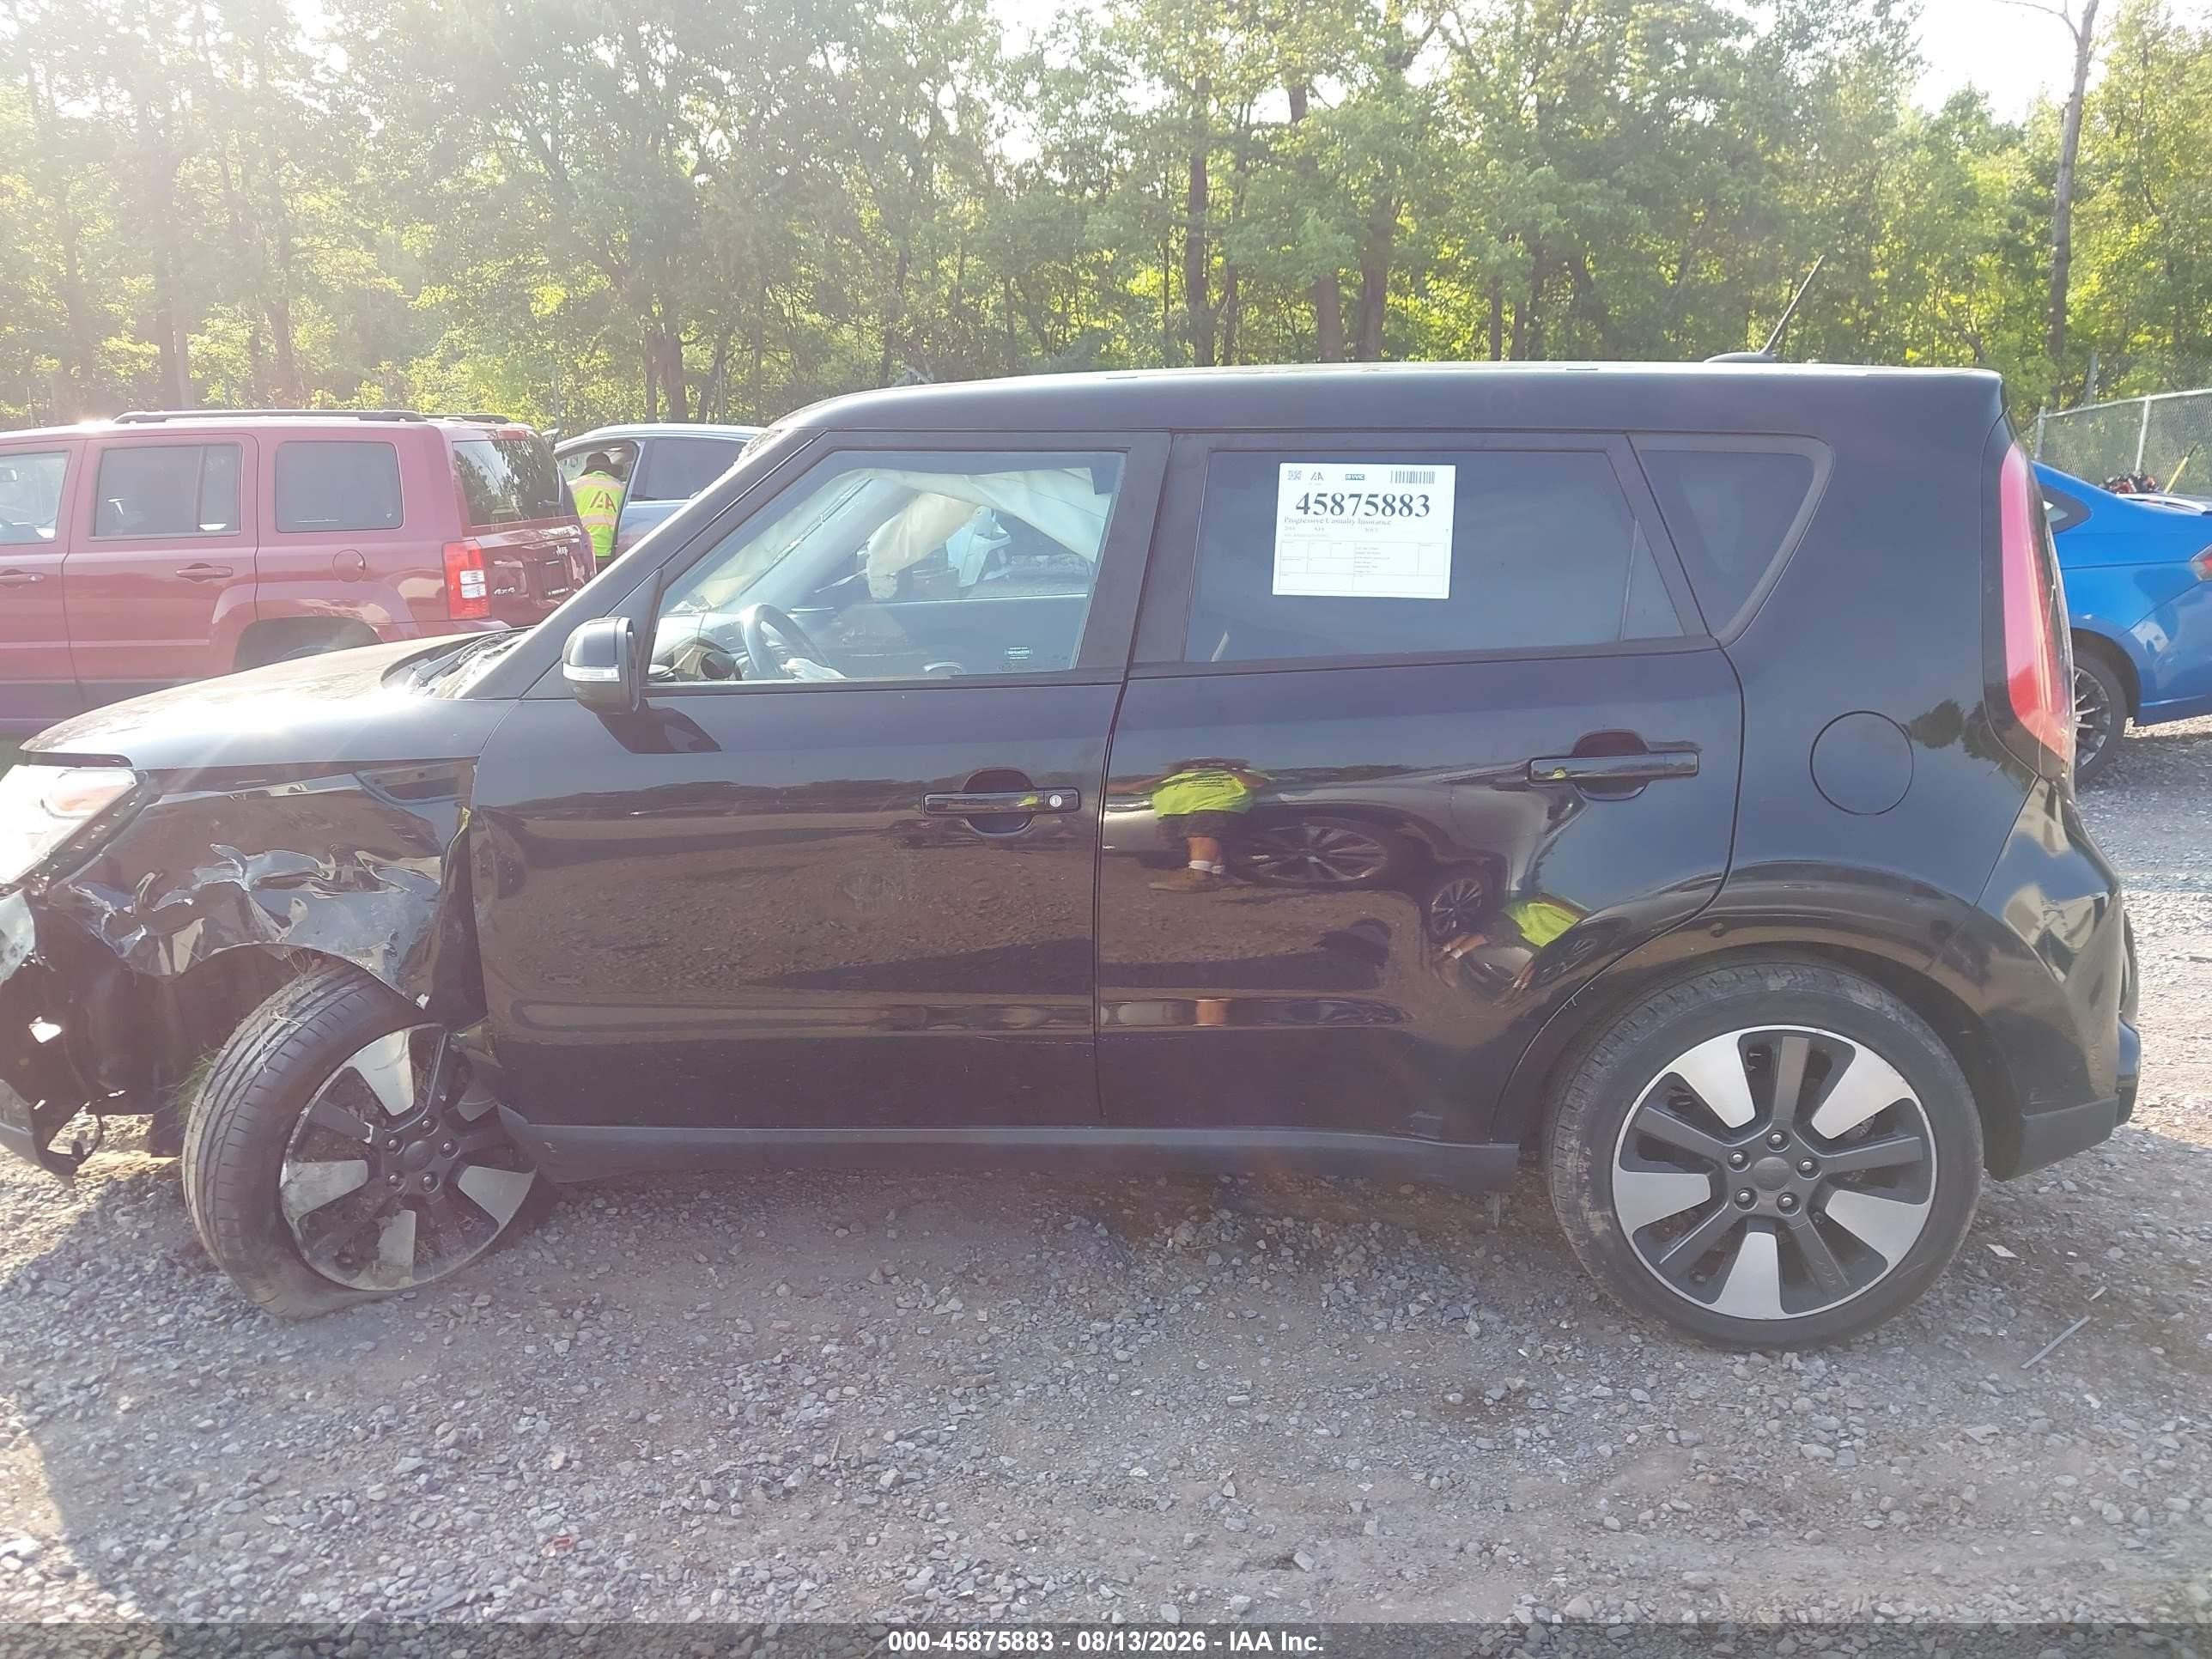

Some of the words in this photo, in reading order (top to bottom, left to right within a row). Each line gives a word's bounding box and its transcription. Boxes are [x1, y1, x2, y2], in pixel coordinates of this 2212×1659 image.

[1295, 491, 1430, 518] 45875883
[1284, 516, 1324, 526] Progressive
[1358, 518, 1392, 526] Insurance
